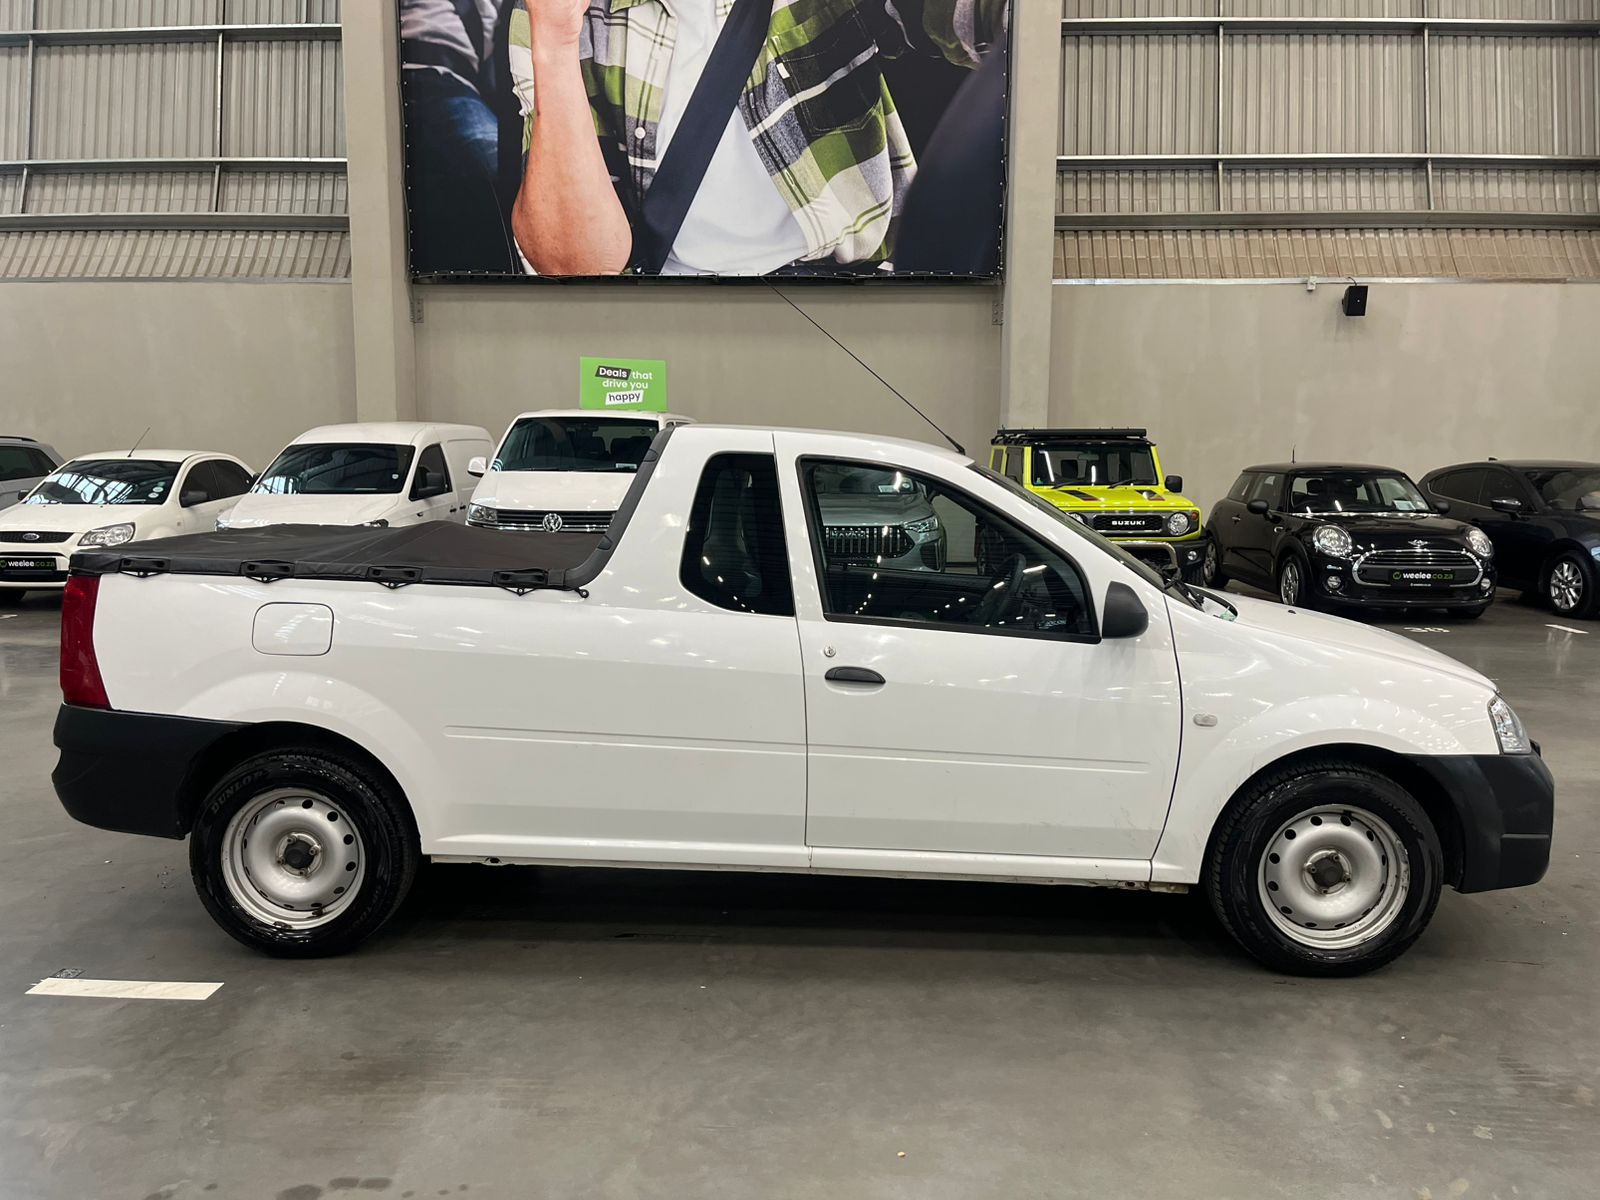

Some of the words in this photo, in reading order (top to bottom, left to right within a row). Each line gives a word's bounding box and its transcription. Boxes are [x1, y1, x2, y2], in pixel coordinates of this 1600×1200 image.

[599, 367, 628, 378] Deals
[632, 371, 653, 380] that
[602, 379, 628, 388] drive
[630, 382, 649, 391] you
[608, 392, 641, 402] happy
[1403, 571, 1454, 579] weelee.co.za
